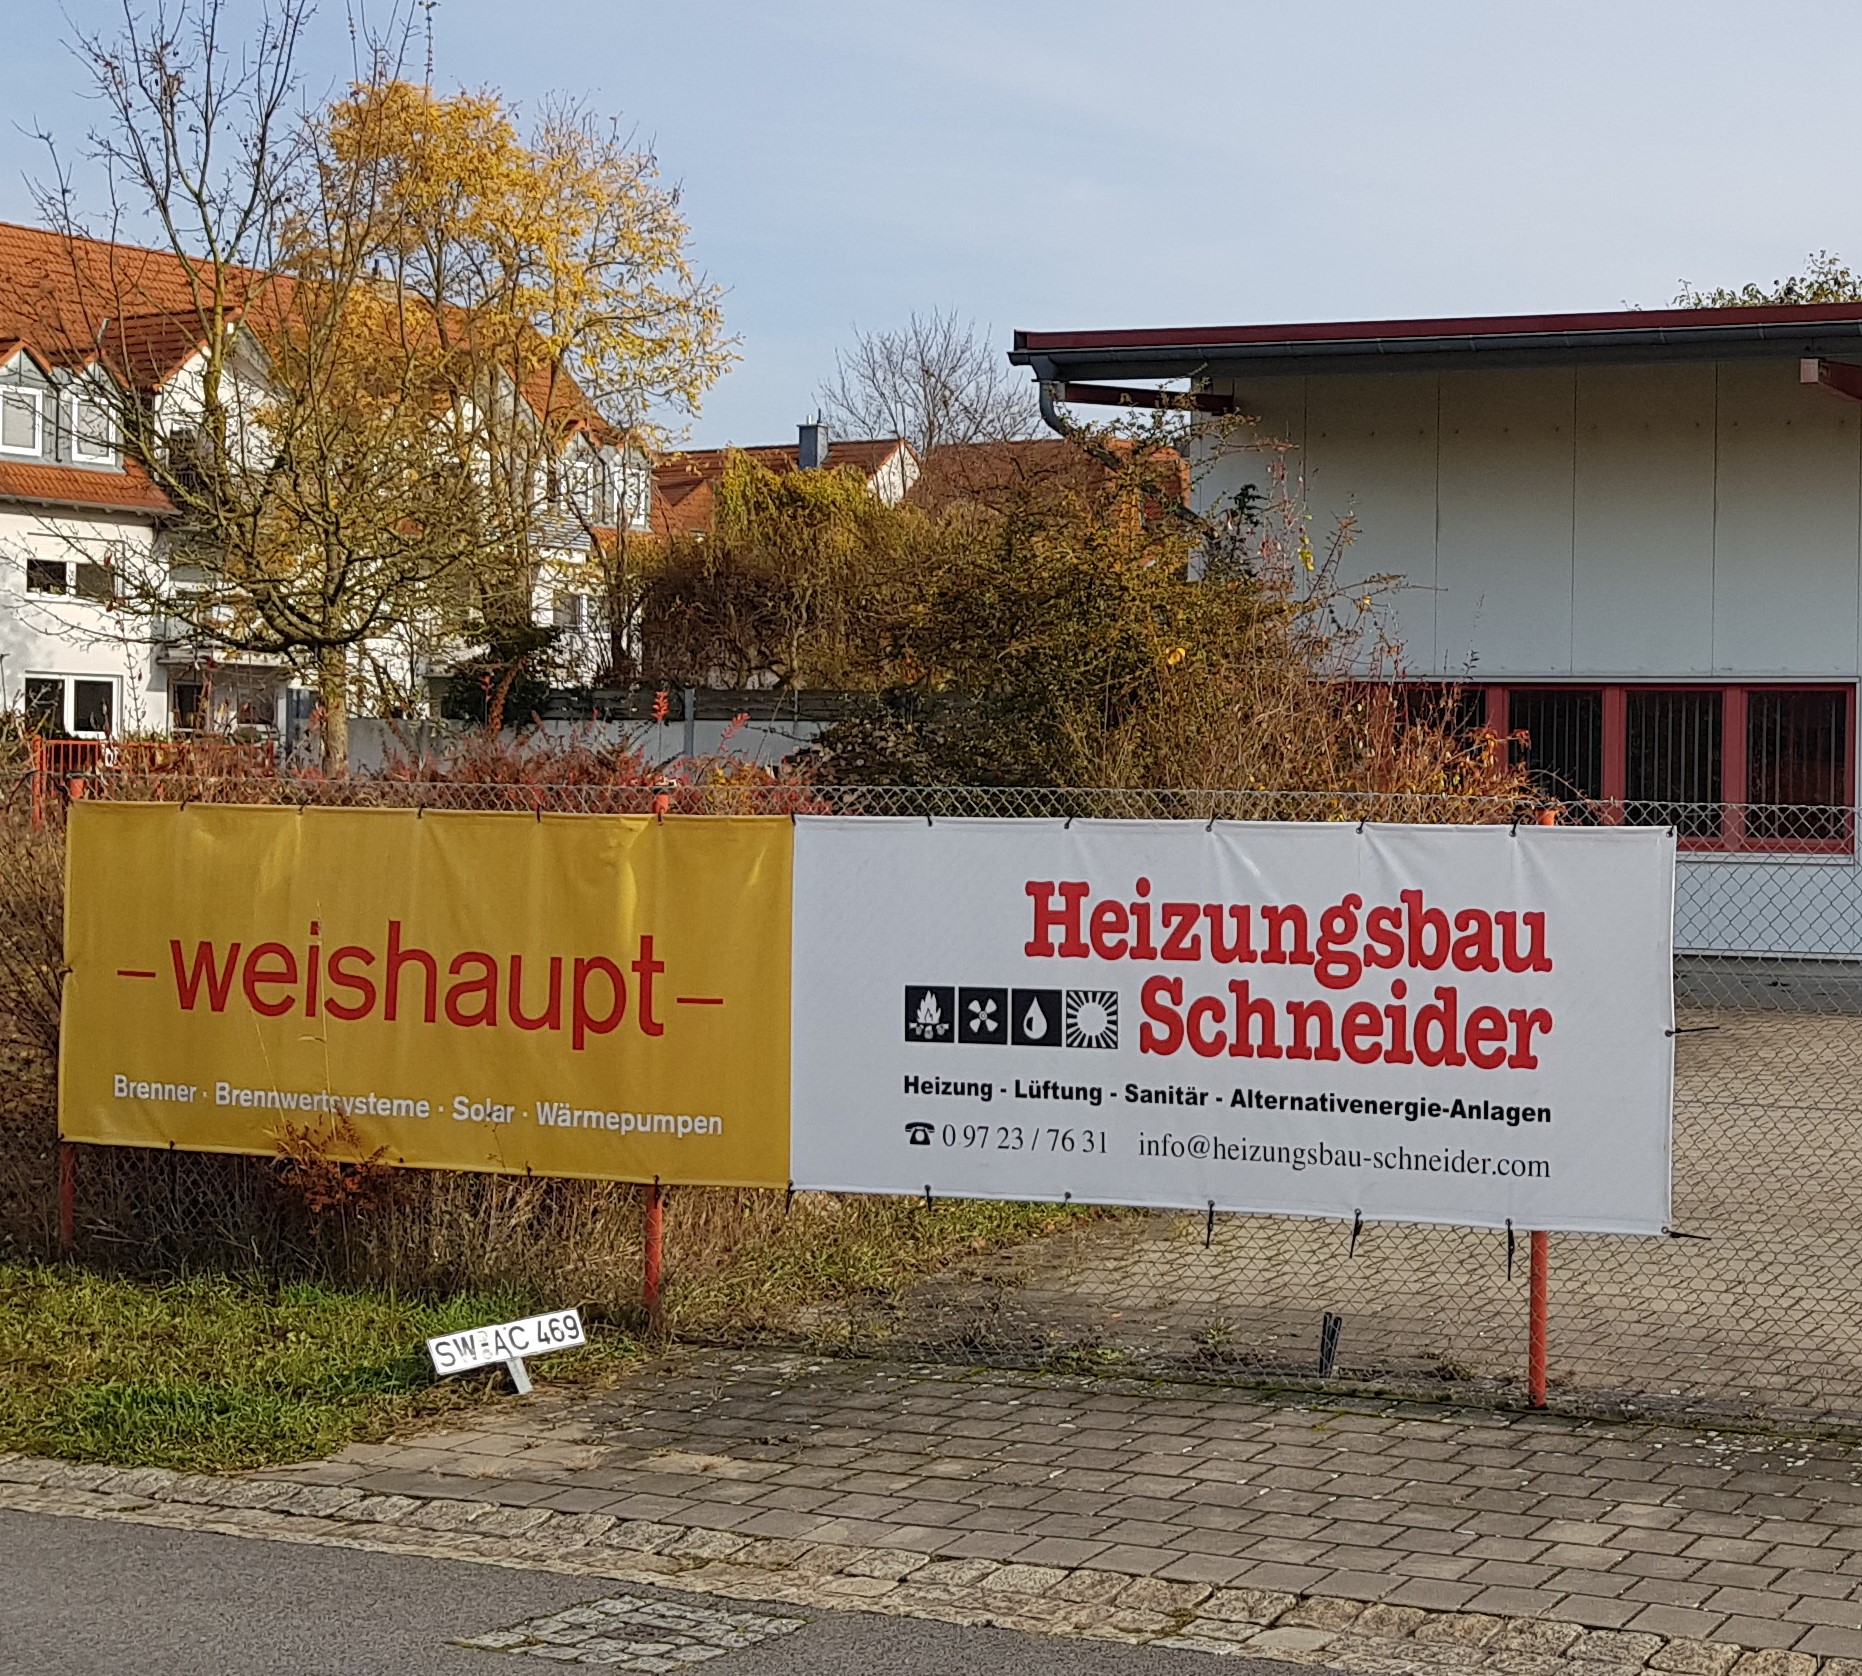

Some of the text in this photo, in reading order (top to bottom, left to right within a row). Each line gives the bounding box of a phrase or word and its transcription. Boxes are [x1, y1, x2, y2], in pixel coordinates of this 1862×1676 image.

[1023, 877, 1554, 990] Heizungsbau
[1138, 974, 1554, 1071] Schneider
[113, 1074, 197, 1103] Brenner
[452, 1095, 515, 1123] Solar
[535, 1101, 723, 1138] Wärmepumpen
[904, 1075, 993, 1102] Heizung
[1014, 1079, 1103, 1106] Lüftung
[1124, 1083, 1209, 1106] Sanitär
[1229, 1088, 1551, 1127] Alternativenergie-Anlagen
[942, 1123, 1107, 1154] 0 97 23 / 76 31
[1138, 1131, 1551, 1179] info@heizungsbau-schneider.com
[536, 1314, 580, 1345] 469
